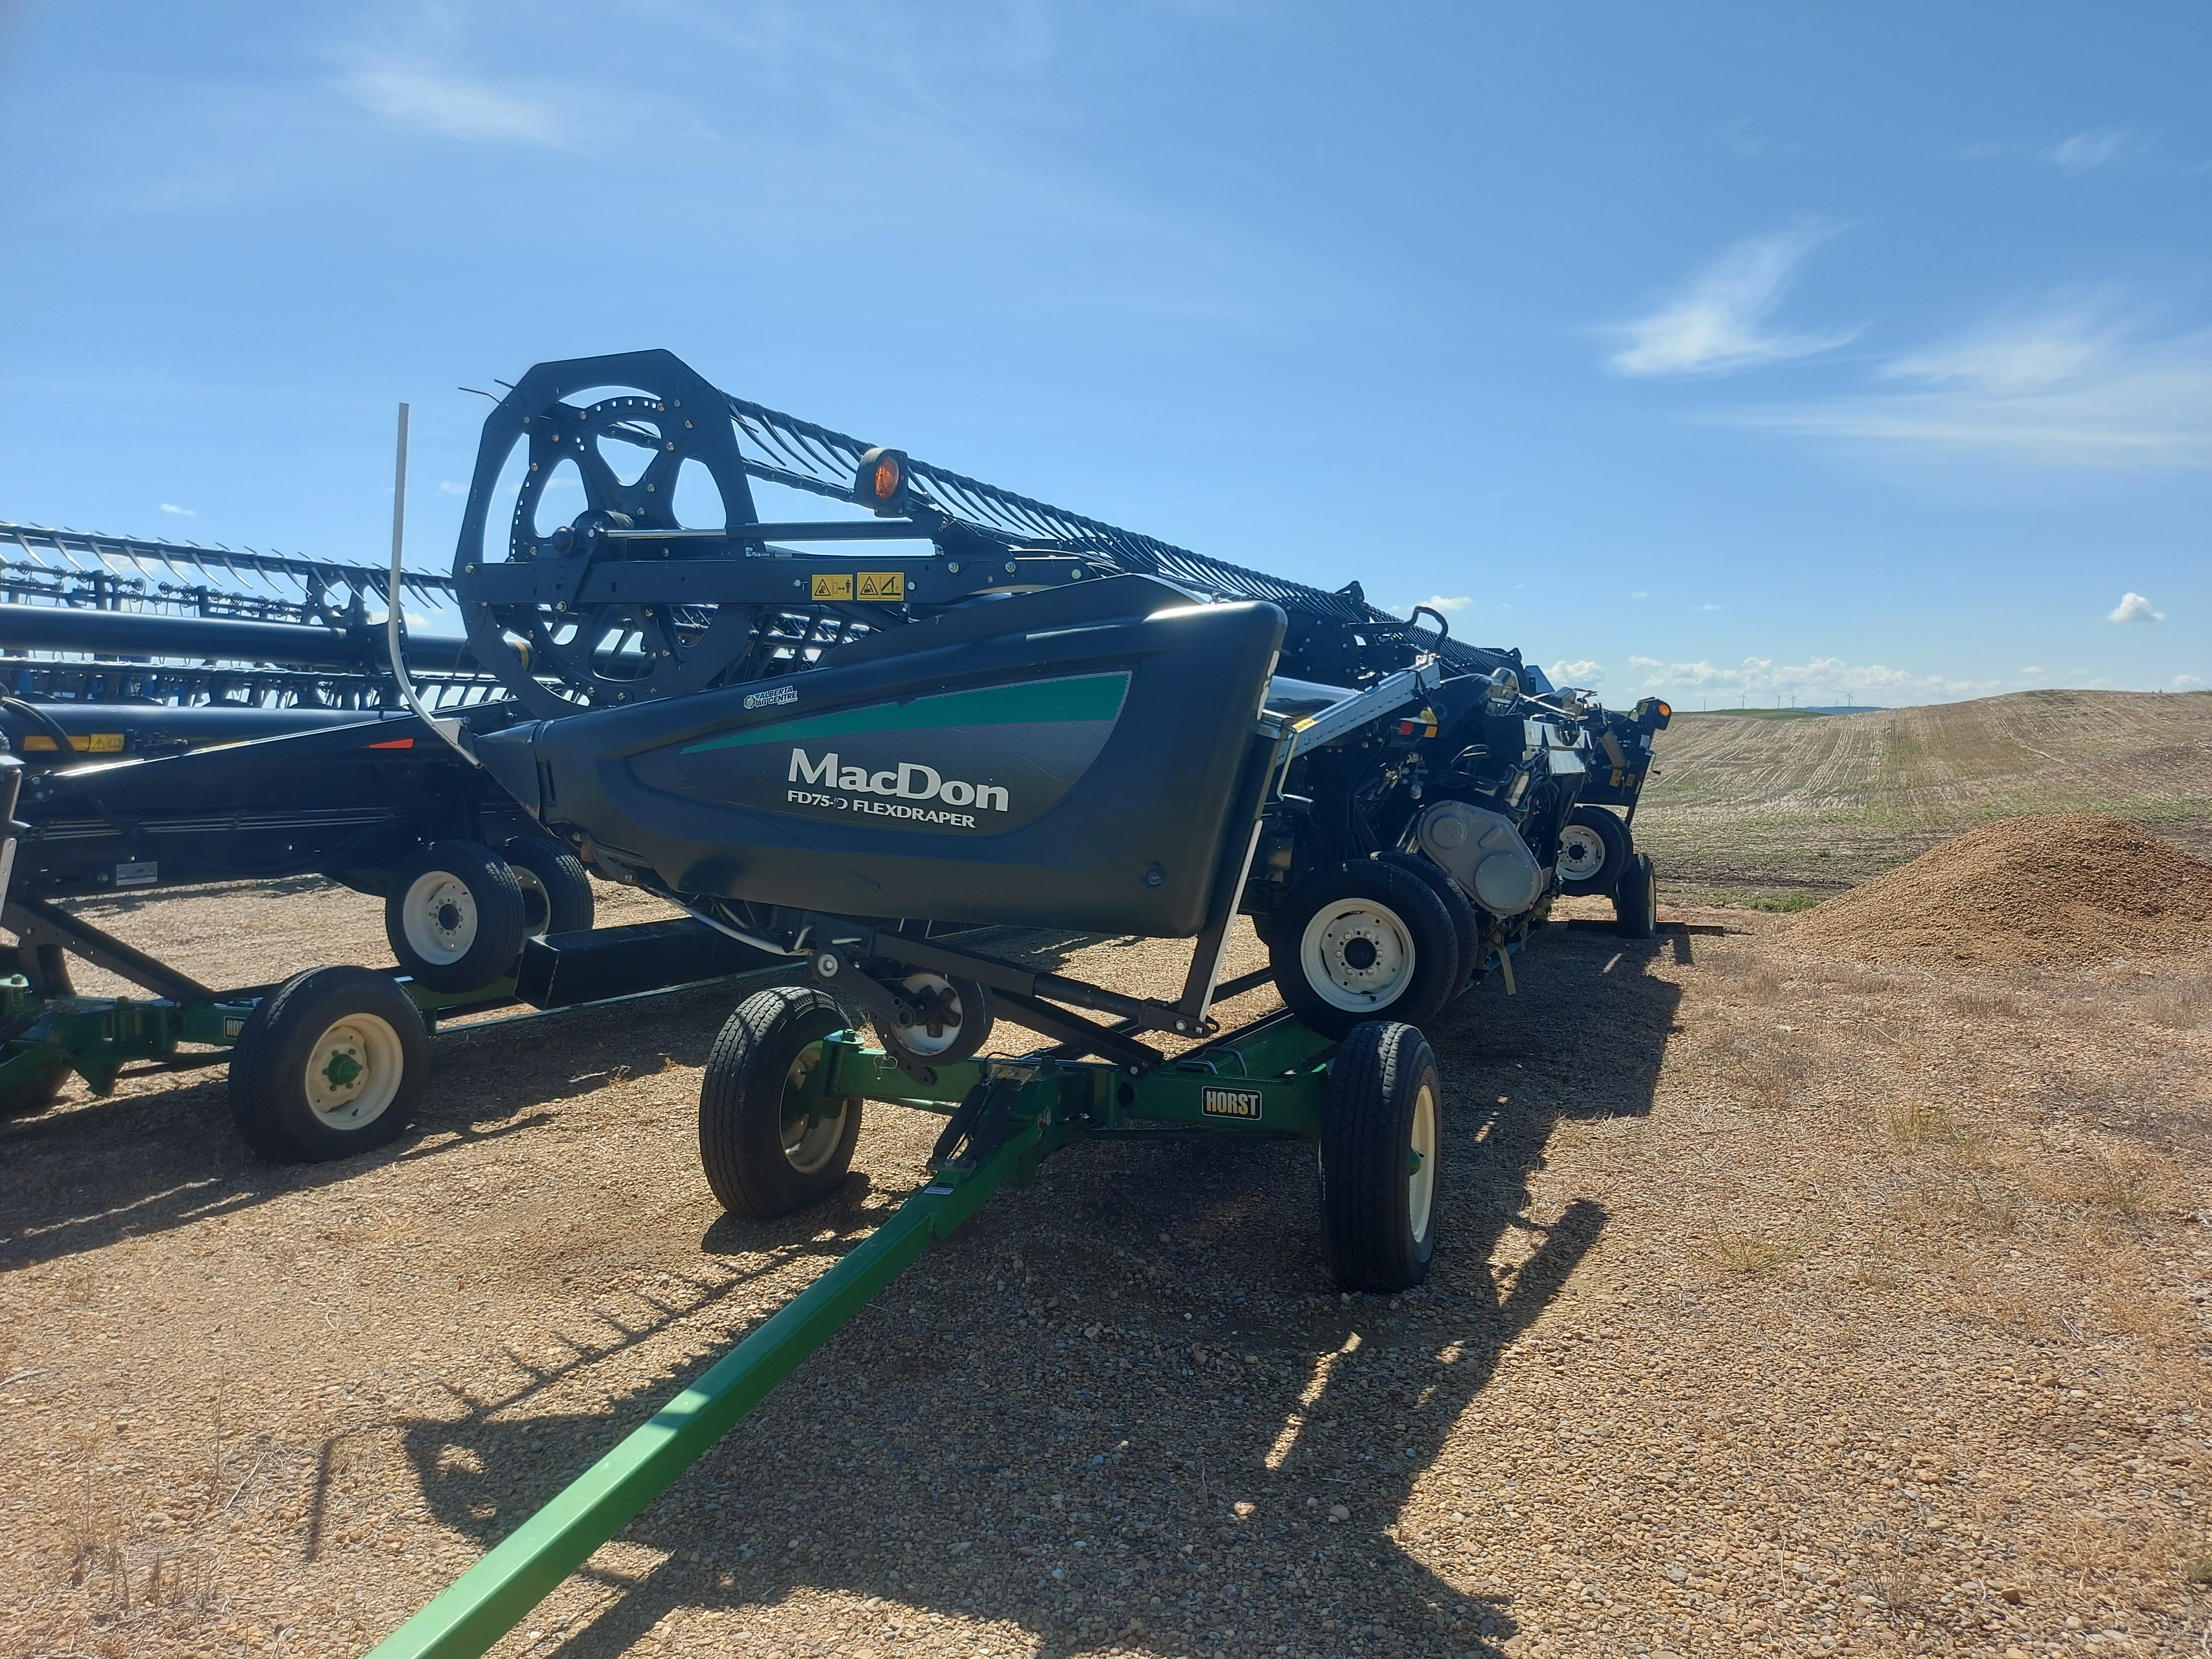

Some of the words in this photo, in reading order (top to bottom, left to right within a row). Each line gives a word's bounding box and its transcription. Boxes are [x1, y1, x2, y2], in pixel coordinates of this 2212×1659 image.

[760, 687, 793, 699] ALBERTA
[768, 692, 796, 704] CENTRE
[787, 748, 1009, 812] MacDon
[853, 799, 976, 828] FLEXDRAPER
[1206, 1091, 1259, 1116] HORST
